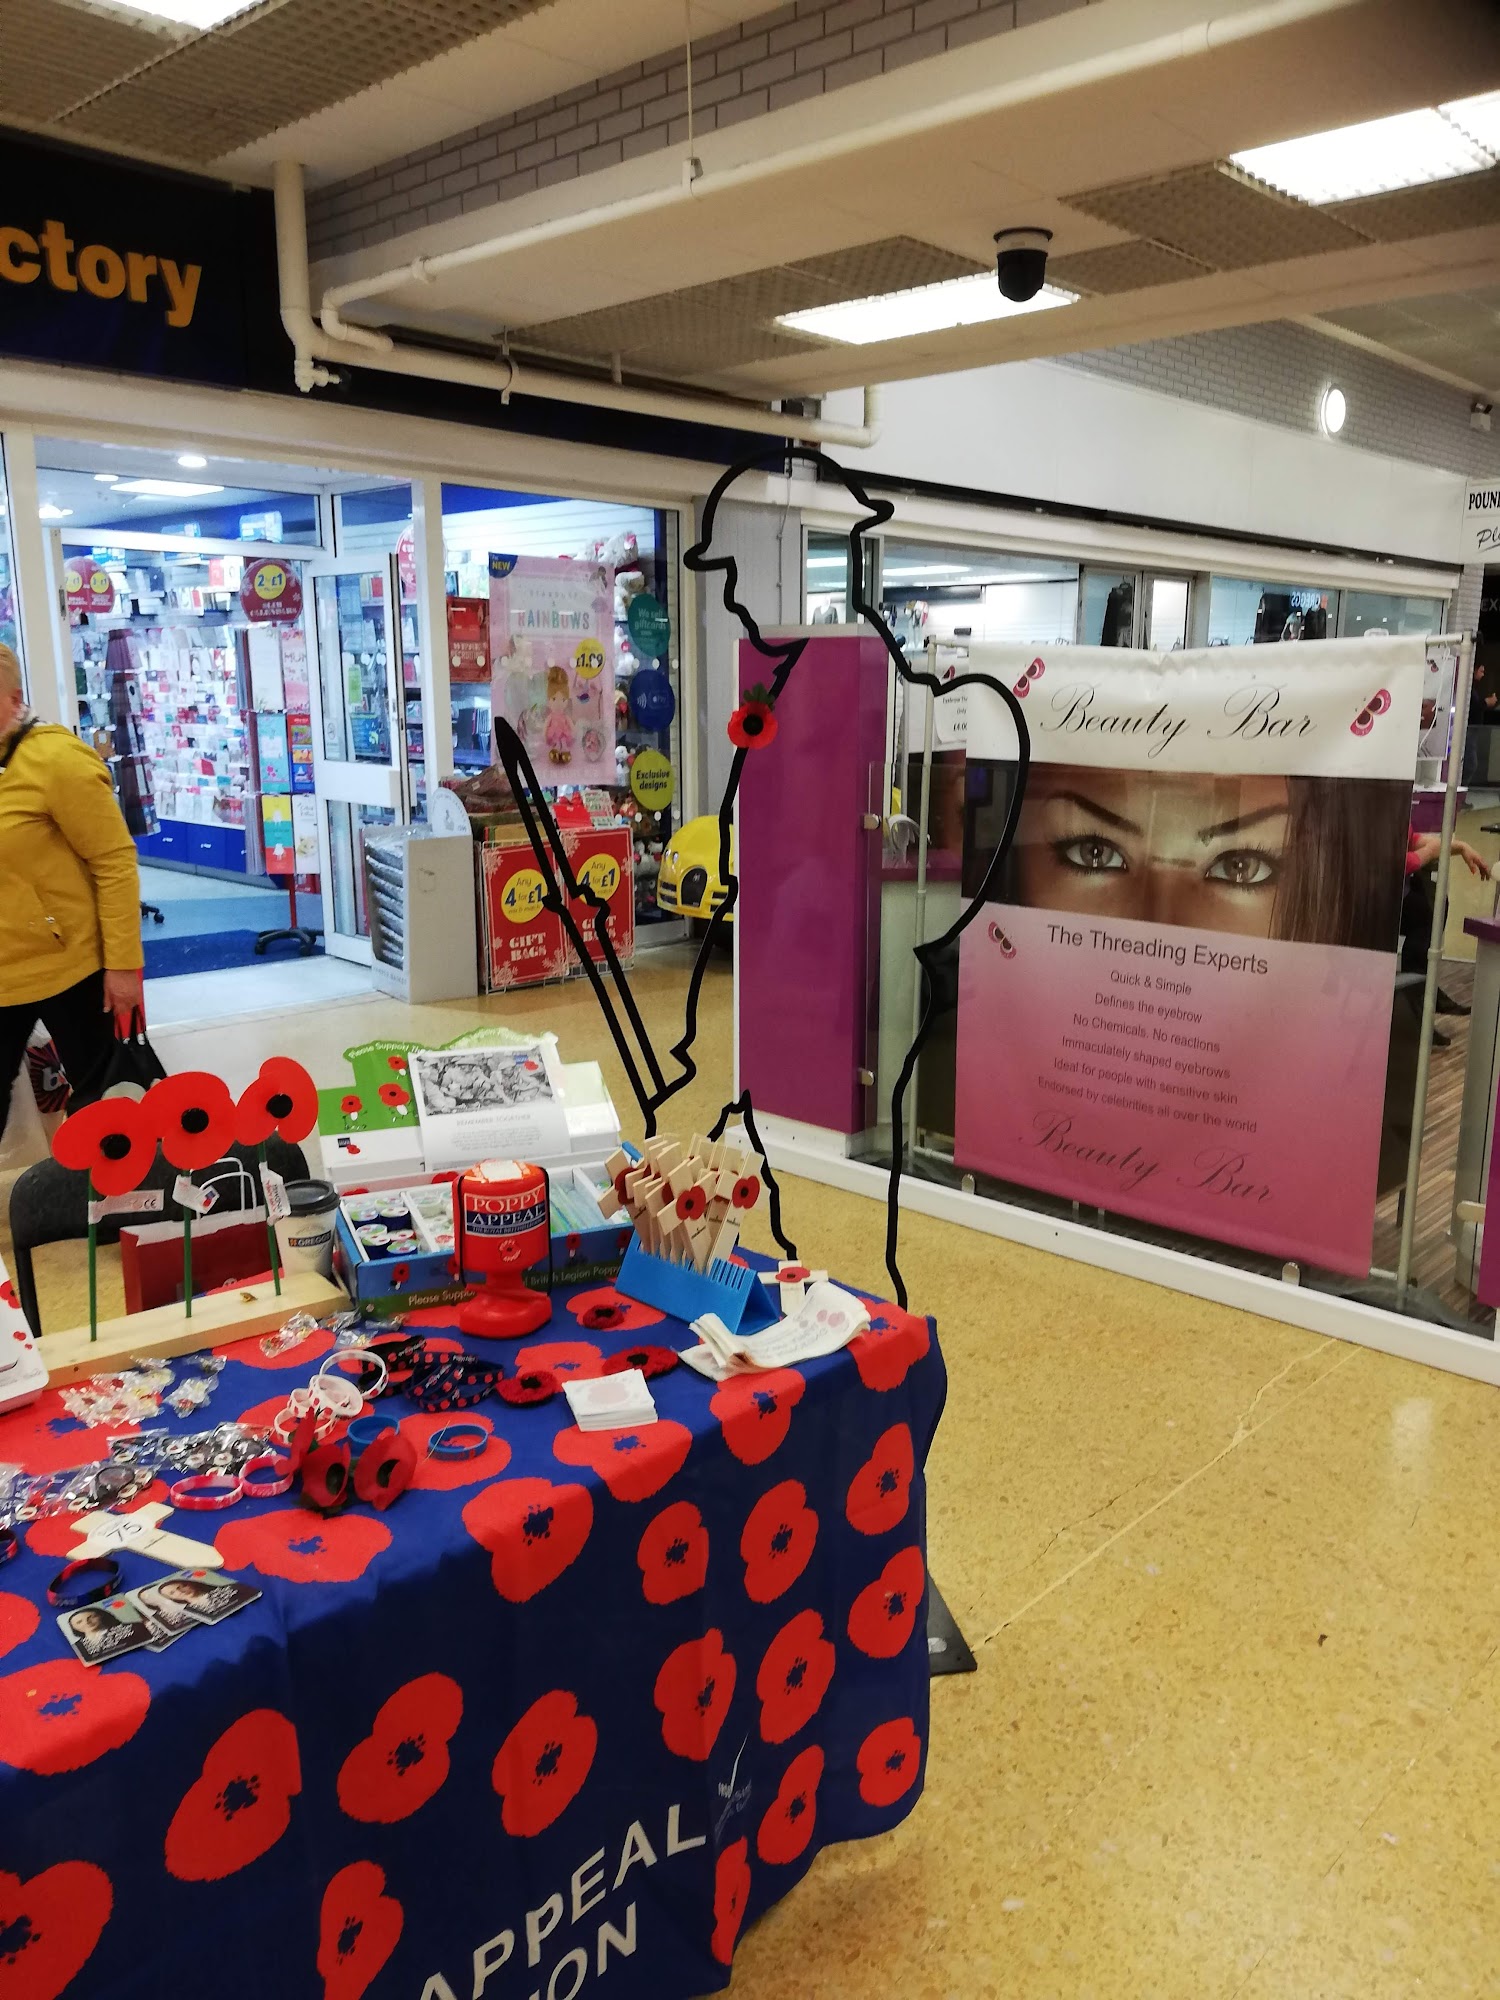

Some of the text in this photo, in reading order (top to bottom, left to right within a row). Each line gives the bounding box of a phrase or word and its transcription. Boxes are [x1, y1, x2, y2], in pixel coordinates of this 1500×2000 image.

[0, 219, 202, 328] ctory
[492, 561, 511, 571] NEW
[1040, 682, 1318, 760] Beauty Bar
[635, 769, 670, 781] Exclusive
[639, 778, 668, 791] designs
[592, 861, 606, 871] Any
[601, 867, 616, 888] £1
[505, 887, 517, 907] 4
[528, 883, 543, 904] £1
[516, 878, 532, 887] Any
[582, 914, 617, 930] GIT
[509, 932, 547, 949] GIFT
[1047, 924, 1268, 974] The Threading Experts
[511, 945, 547, 962] BAGS
[1110, 970, 1192, 995] Quick & Simple
[1095, 992, 1203, 1023] Defines the eyebrow
[1073, 1013, 1089, 1027] No
[1153, 1028, 1168, 1042] No
[1170, 1034, 1220, 1053] reactions
[1062, 1036, 1231, 1079] Immaculately shaped eyebrows
[1054, 1057, 1238, 1105] Ideal for people with sensitive skin
[1038, 1075, 1257, 1133] Endorsed by celebrities all over the world
[1018, 1110, 1274, 1202] Beauty Bar
[472, 1188, 541, 1213] POPPY
[472, 1204, 543, 1225] APPEAL
[408, 1291, 440, 1306] Please
[561, 1267, 591, 1282] Legion
[593, 1264, 620, 1279] Poppy
[106, 1522, 143, 1542] 75
[528, 1900, 637, 2000] ON
